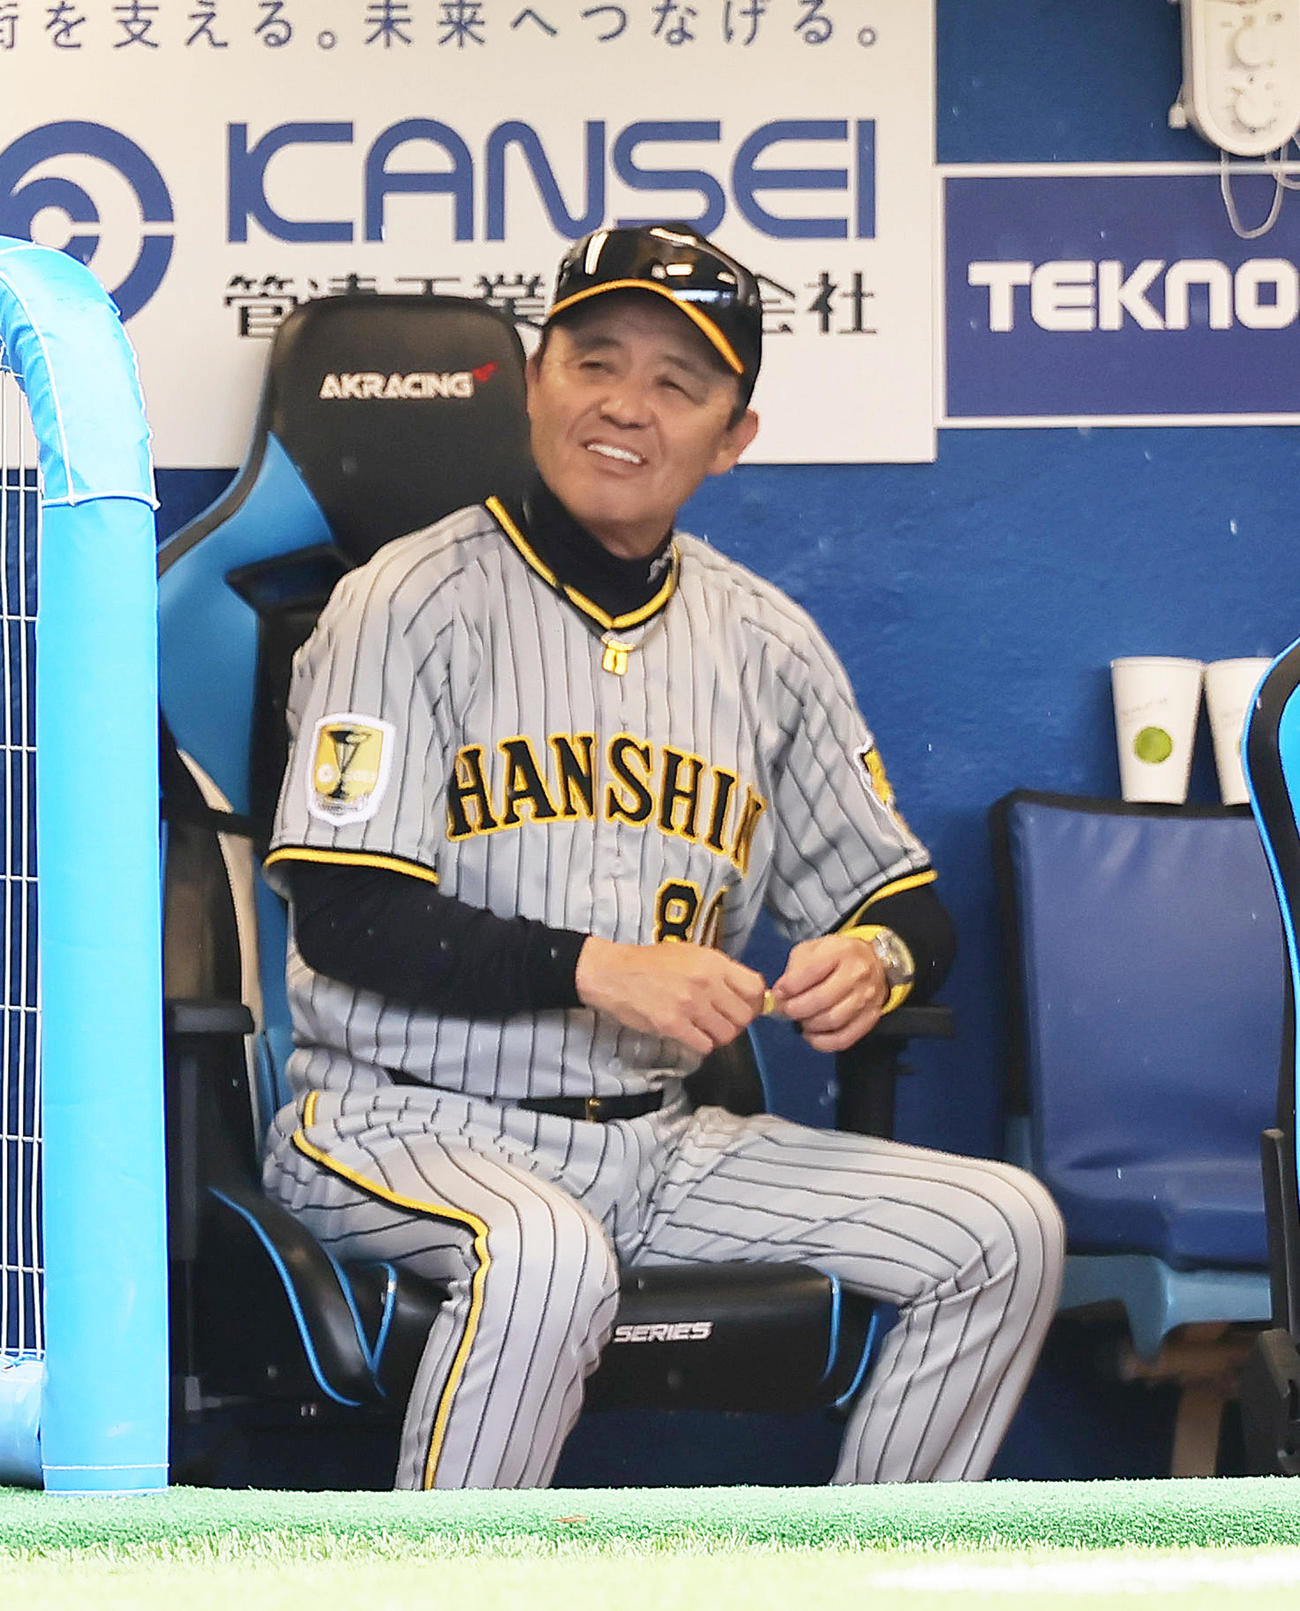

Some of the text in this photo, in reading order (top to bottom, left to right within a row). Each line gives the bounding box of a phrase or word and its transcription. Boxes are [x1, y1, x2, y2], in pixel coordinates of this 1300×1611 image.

[227, 118, 876, 243] KANSEI
[967, 258, 1300, 332] TEKNO
[319, 372, 475, 400] AKRACING
[613, 1321, 713, 1343] SERIES
